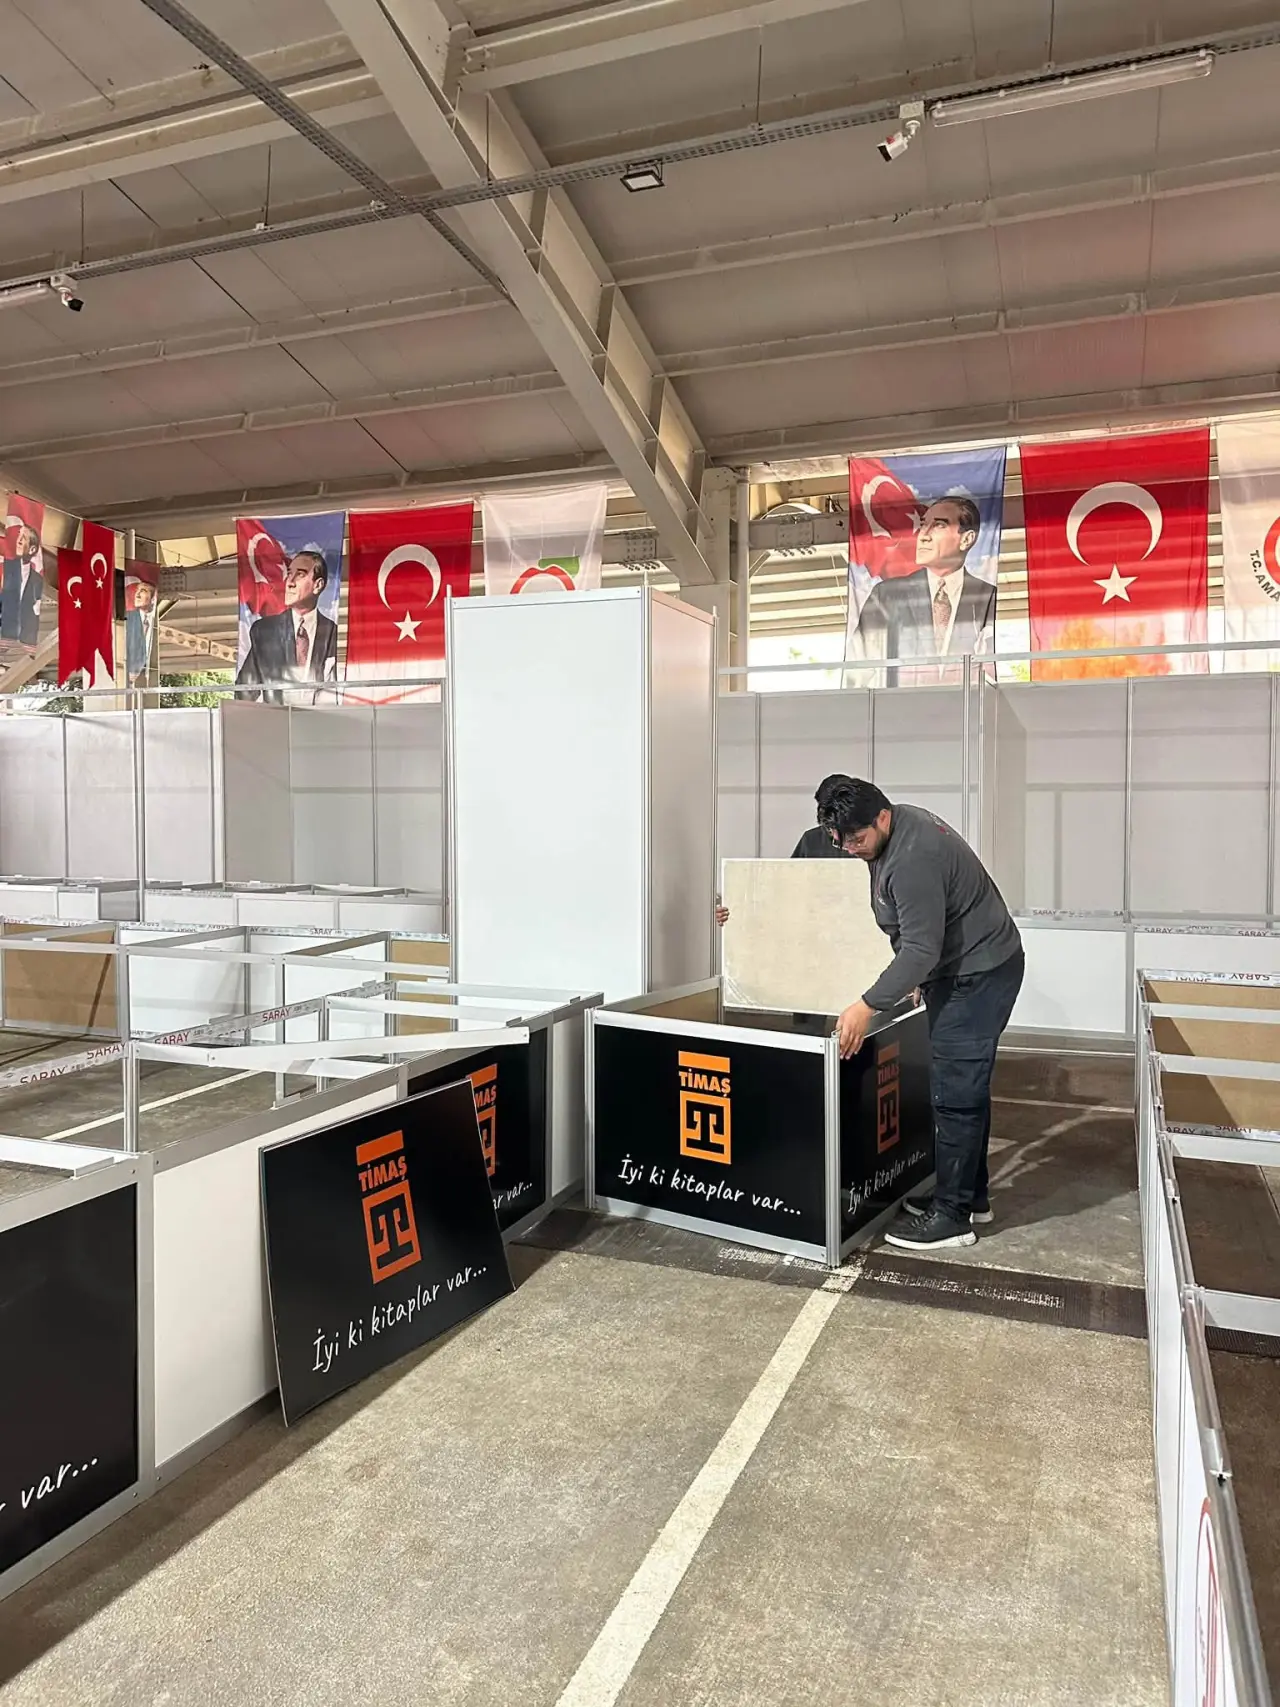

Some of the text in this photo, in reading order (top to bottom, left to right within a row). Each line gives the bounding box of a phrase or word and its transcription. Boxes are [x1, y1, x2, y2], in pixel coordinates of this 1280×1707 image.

[262, 1007, 292, 1022] SARAY
[87, 1042, 126, 1060] SARAY
[154, 1032, 190, 1045] SARAY
[678, 1068, 731, 1097] TİMAŞ
[475, 1084, 497, 1108] MAŞ
[1166, 1126, 1196, 1134] ARAY
[358, 1155, 408, 1193] TİMAŞ
[618, 1153, 801, 1215] İyi ki kitaplar var...
[874, 1159, 905, 1192] kitaplar
[507, 1182, 533, 1202] var...
[312, 1265, 487, 1373] İyi ki kitaplar var...
[21, 1458, 98, 1509] var...
